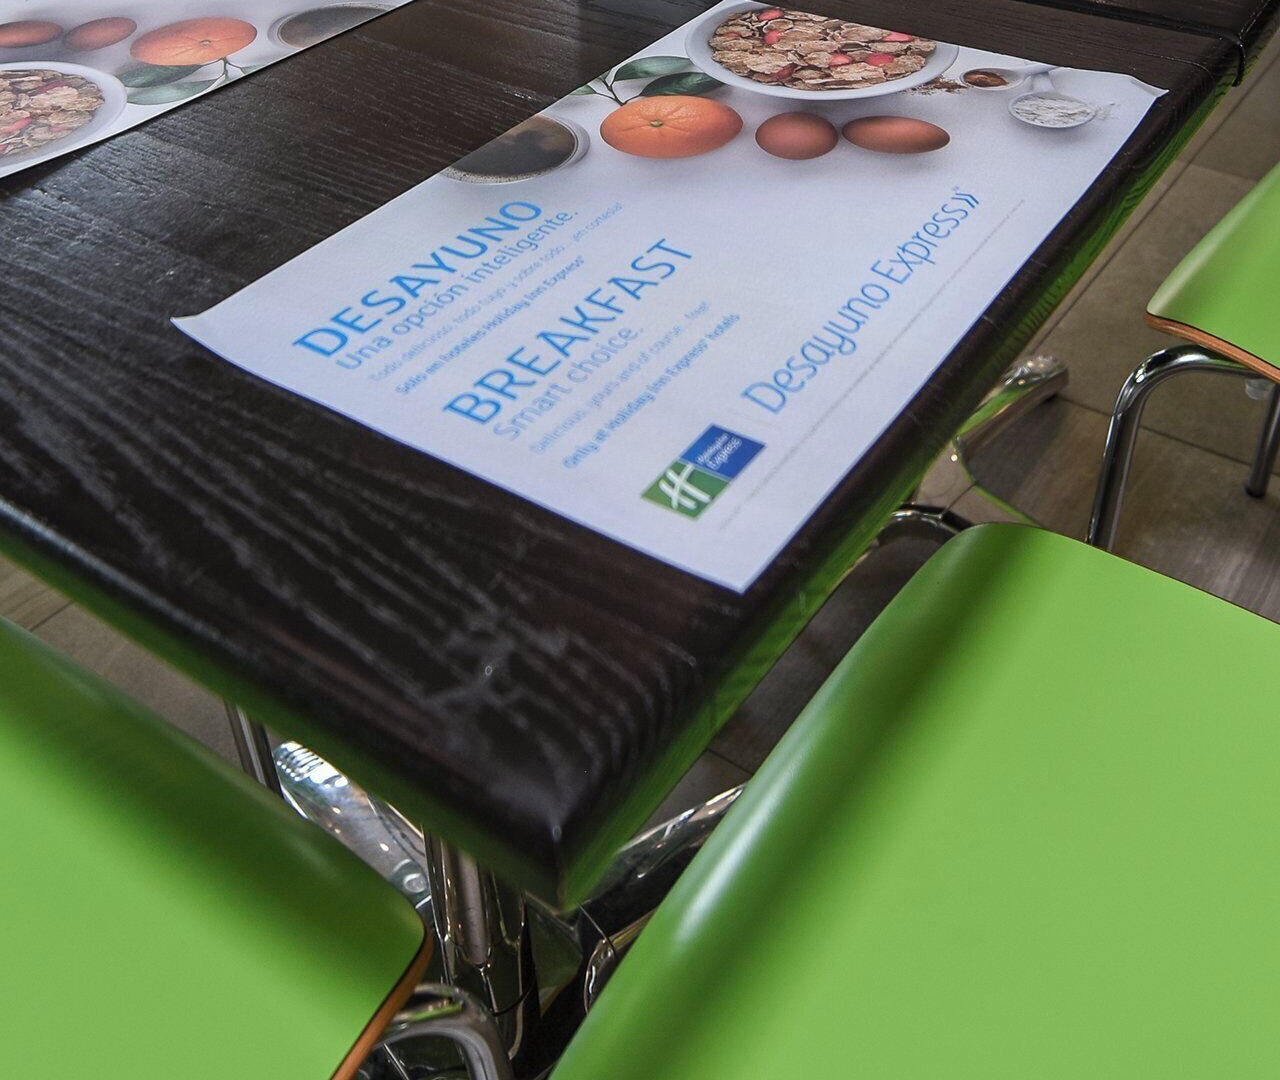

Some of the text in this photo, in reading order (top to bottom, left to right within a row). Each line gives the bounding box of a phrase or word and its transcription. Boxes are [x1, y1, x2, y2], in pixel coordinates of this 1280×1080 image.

[293, 201, 542, 357] DESAYUNO
[336, 211, 578, 370] Una opción inteligente.
[443, 239, 692, 424] BREAKFAST
[740, 283, 890, 414] Desayuno
[493, 328, 643, 440] Smart choice.
